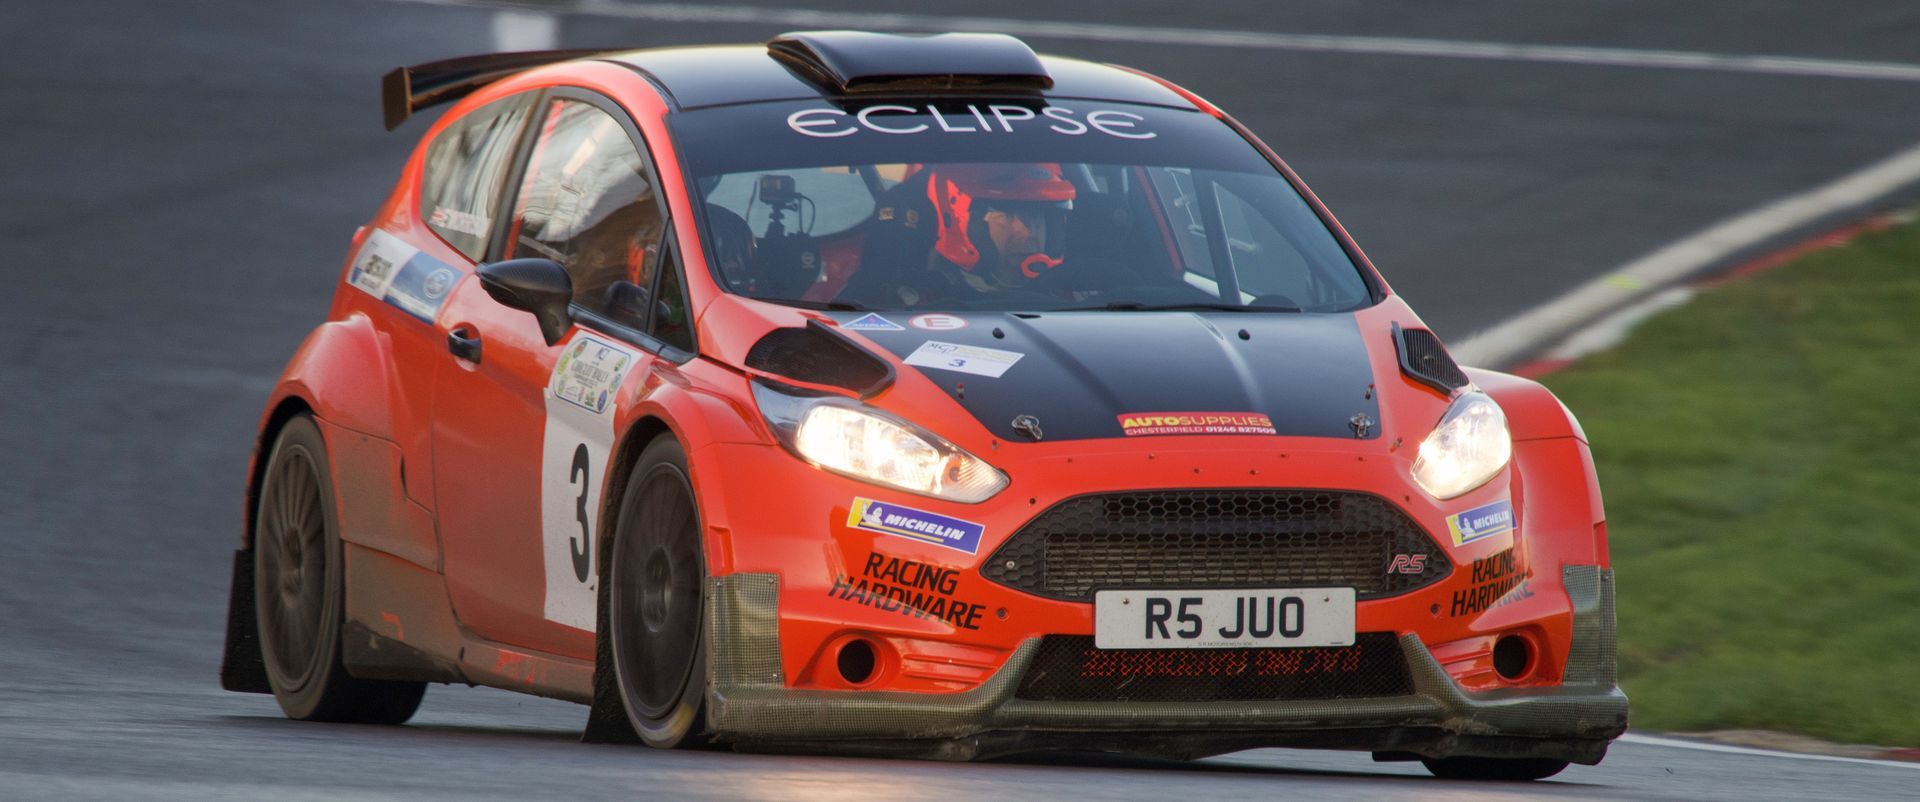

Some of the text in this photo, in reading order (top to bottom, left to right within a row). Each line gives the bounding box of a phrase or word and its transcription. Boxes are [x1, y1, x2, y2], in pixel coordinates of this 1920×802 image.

[787, 104, 1158, 139] ECLIPSE
[1125, 426, 1203, 435] CHESTERFIELD
[569, 442, 590, 584] 3
[885, 513, 966, 541] MICHELIN
[1473, 510, 1510, 531] MICHELIN
[863, 551, 961, 596] RACING
[1387, 553, 1428, 575] RS
[828, 572, 987, 631] HARDWARE
[1145, 596, 1305, 639] R5 JUO
